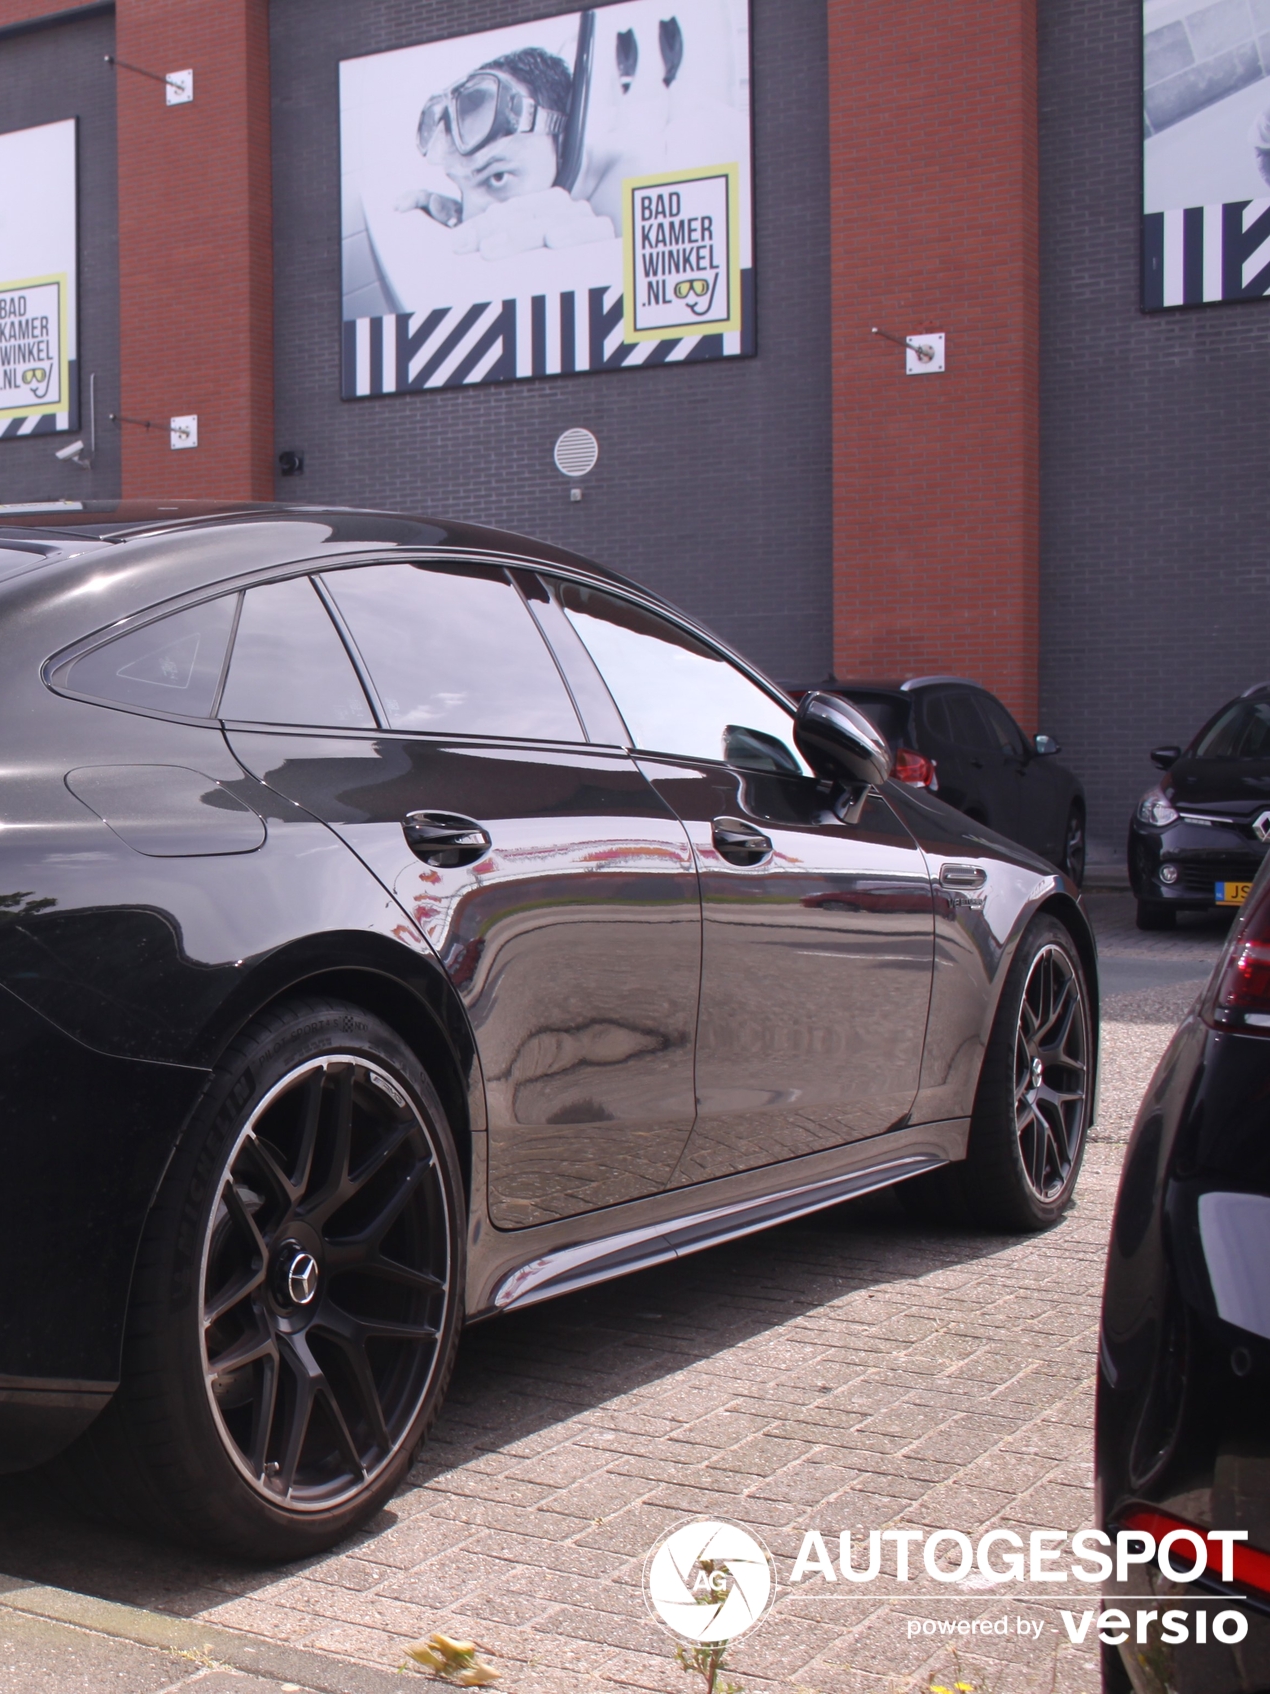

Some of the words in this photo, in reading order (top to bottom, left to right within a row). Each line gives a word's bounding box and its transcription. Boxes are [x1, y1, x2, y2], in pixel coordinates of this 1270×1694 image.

[641, 192, 681, 221] BAD
[641, 216, 713, 250] KAMER
[642, 245, 720, 278] WINKEL
[0, 316, 50, 343] KAMER
[0, 340, 54, 367] WINKEL
